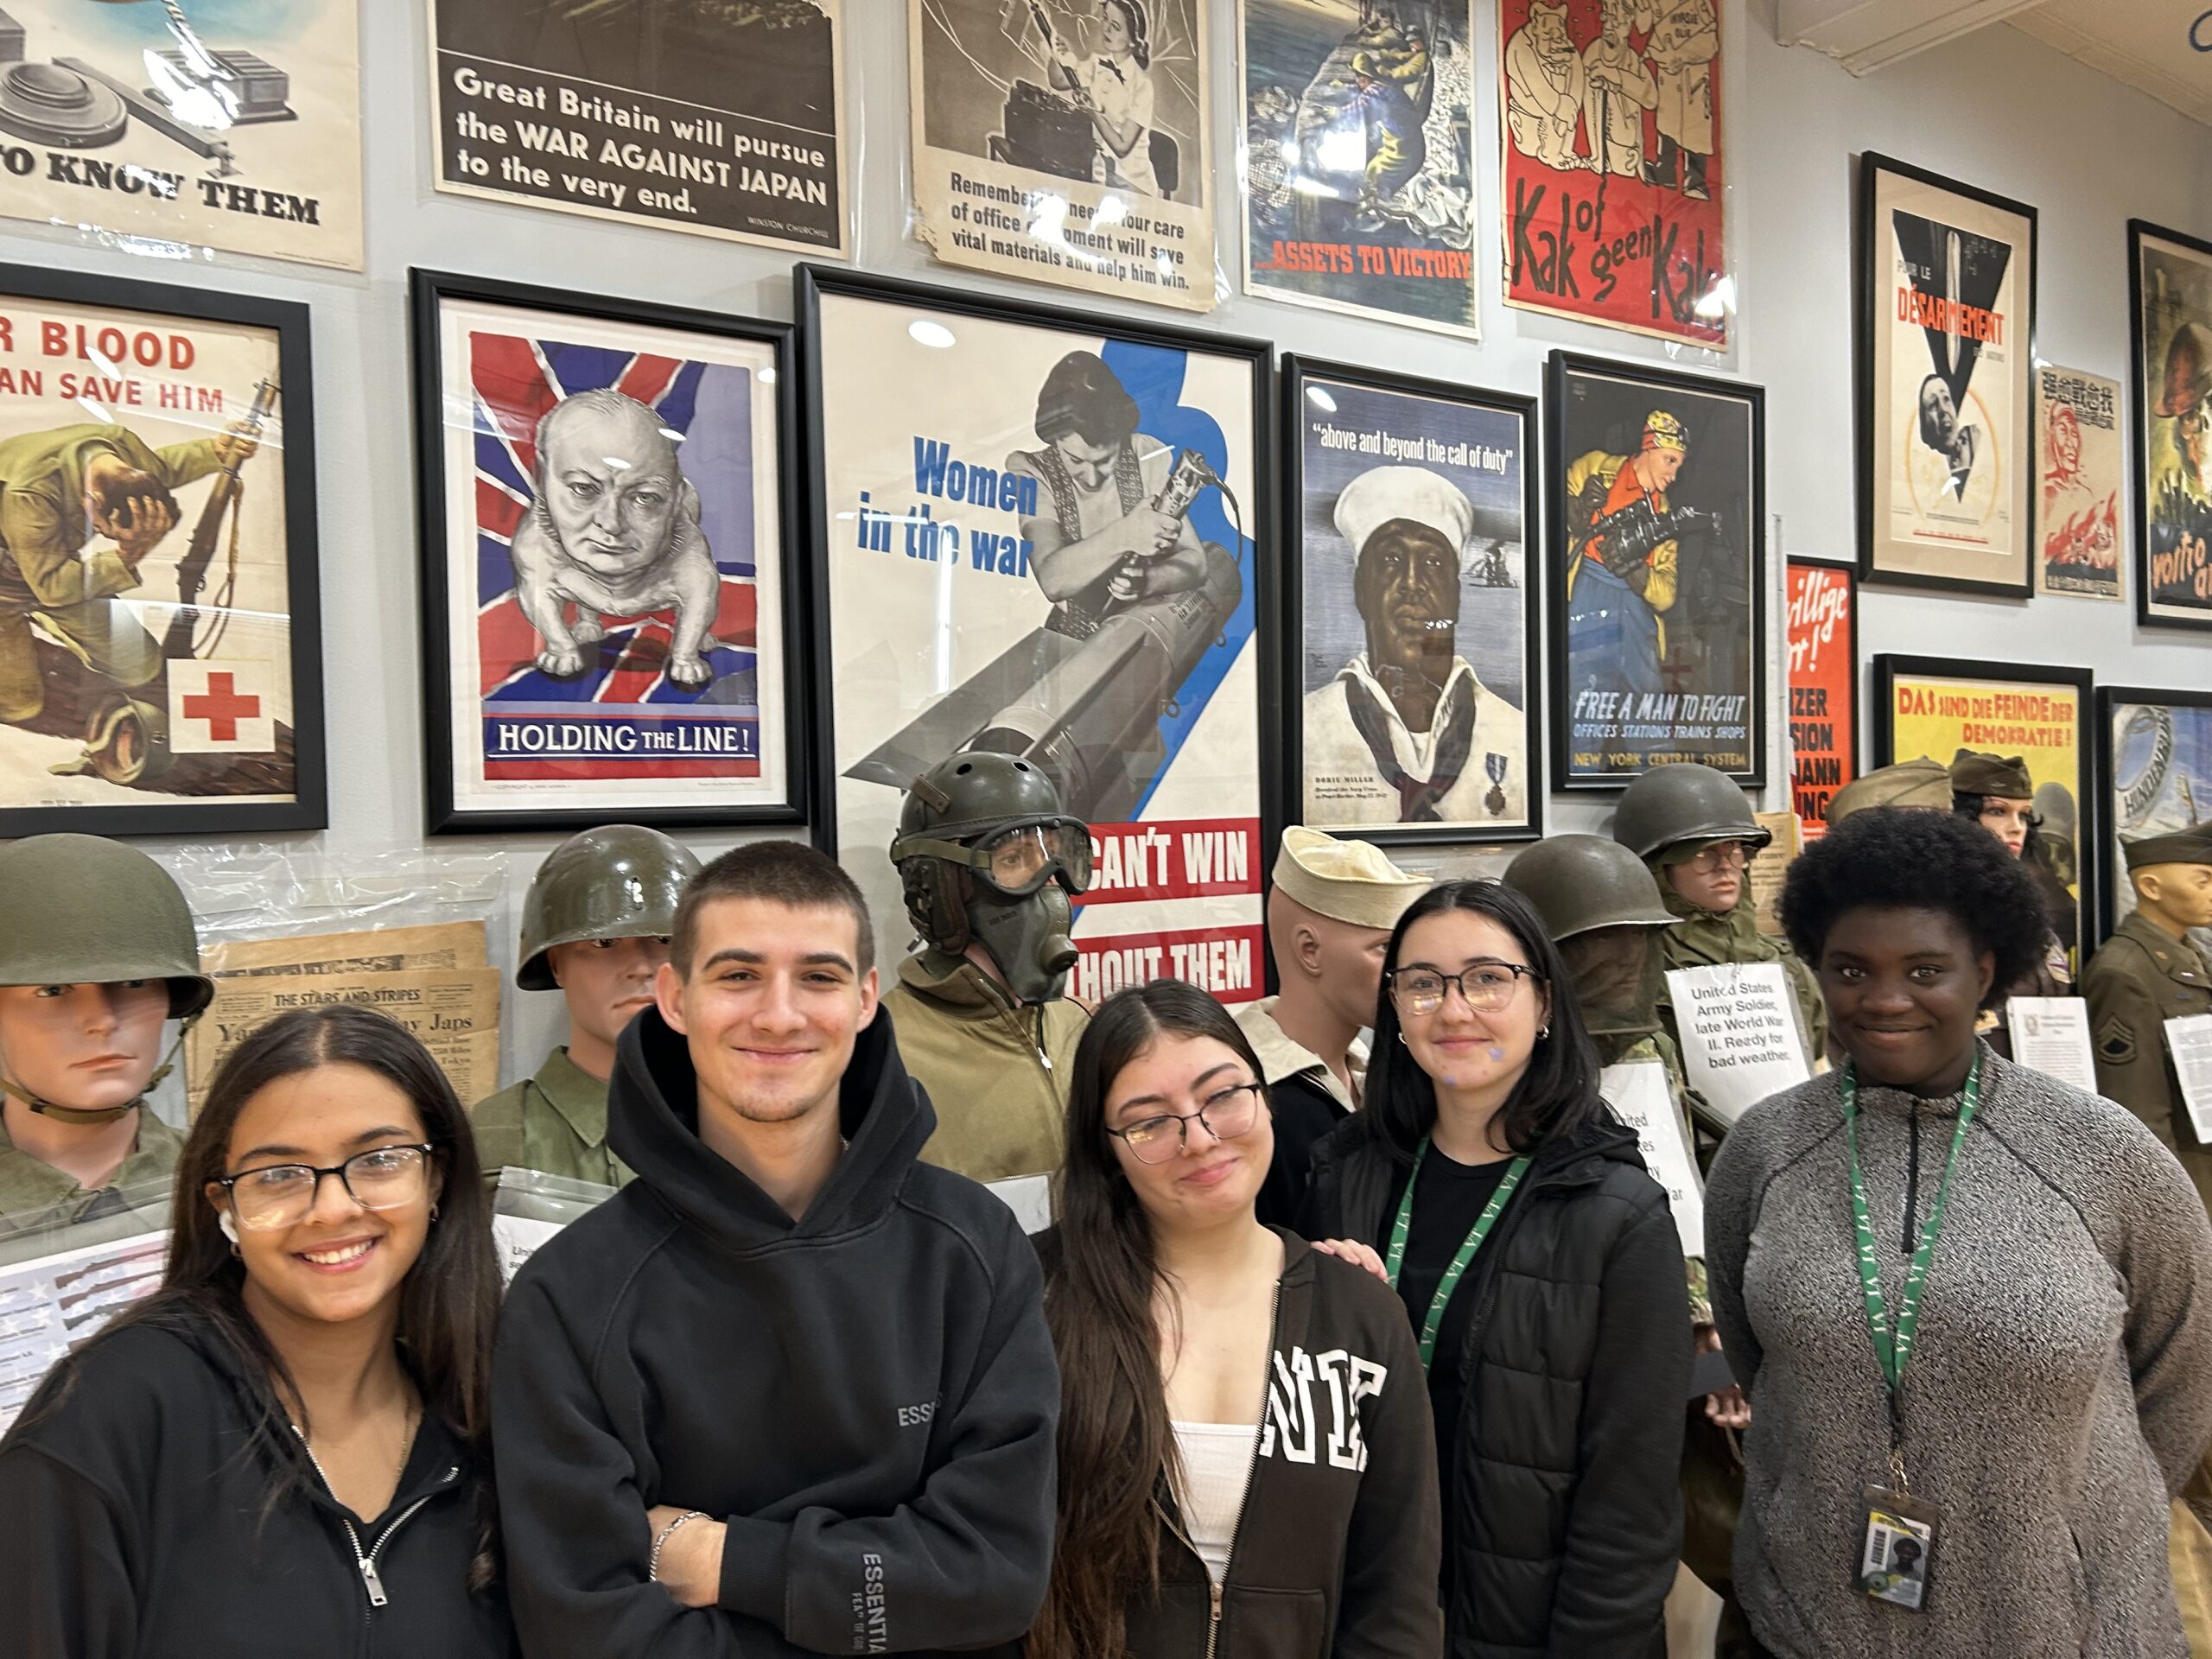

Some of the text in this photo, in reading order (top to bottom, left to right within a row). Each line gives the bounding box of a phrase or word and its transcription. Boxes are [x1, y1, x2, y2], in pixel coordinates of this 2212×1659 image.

[453, 67, 825, 168] Great Britain will pursue
[456, 111, 828, 206] the WAR AGAINST JAPAN
[46, 152, 185, 200] KNOW
[196, 178, 321, 226] THEM
[457, 149, 489, 176] to
[500, 156, 550, 188] the
[561, 173, 626, 208] very
[638, 188, 696, 213] end.
[951, 202, 969, 221] of
[973, 207, 1020, 232] office
[1117, 236, 1145, 257] will
[1150, 245, 1185, 265] save
[1154, 219, 1185, 240] care
[1512, 177, 1580, 299] Kak
[1576, 176, 1606, 241] of
[1591, 226, 1652, 302] geen
[951, 230, 986, 251] vital
[991, 237, 1061, 266] materials
[1131, 264, 1156, 284] him
[1161, 270, 1190, 289] win.
[1357, 245, 1386, 275] TO
[1389, 247, 1471, 279] VICTORY
[1921, 265, 1931, 280] LE
[41, 321, 195, 370] BLOOD
[60, 373, 142, 406] SAVE
[160, 384, 223, 413] HIM
[1359, 431, 1381, 454] and
[1382, 432, 1424, 461] beyond
[1427, 439, 1446, 462] the
[1448, 443, 1467, 466] call
[1469, 446, 1481, 468] of
[913, 435, 1037, 516] Women
[857, 491, 1034, 578] in the war
[1573, 690, 1745, 722] FREE A MAN TO FIGHT
[1898, 687, 2072, 722] DAS SIND DIE FEINDE DER
[499, 724, 749, 752] HOLDING THE LINE!
[1573, 724, 1746, 740] OFFICES STATIONS TRAINS SHOPS
[1573, 753, 1747, 767] NEW YORK CENTRAL SYSTEM
[1088, 827, 1248, 890] CAN'T WIN
[1170, 938, 1251, 992] THEM
[274, 994, 297, 1007] THE
[300, 991, 340, 1005] STARS
[346, 990, 372, 1002] AND
[372, 988, 421, 1001] STRIPES
[1691, 982, 1774, 1000] United States
[429, 1014, 472, 1031] Japs
[1694, 1016, 1783, 1034] late World War
[1697, 1003, 1732, 1017] Army
[1726, 1034, 1767, 1049] Ready
[1770, 1033, 1783, 1045] for
[1708, 1056, 1737, 1069] bad
